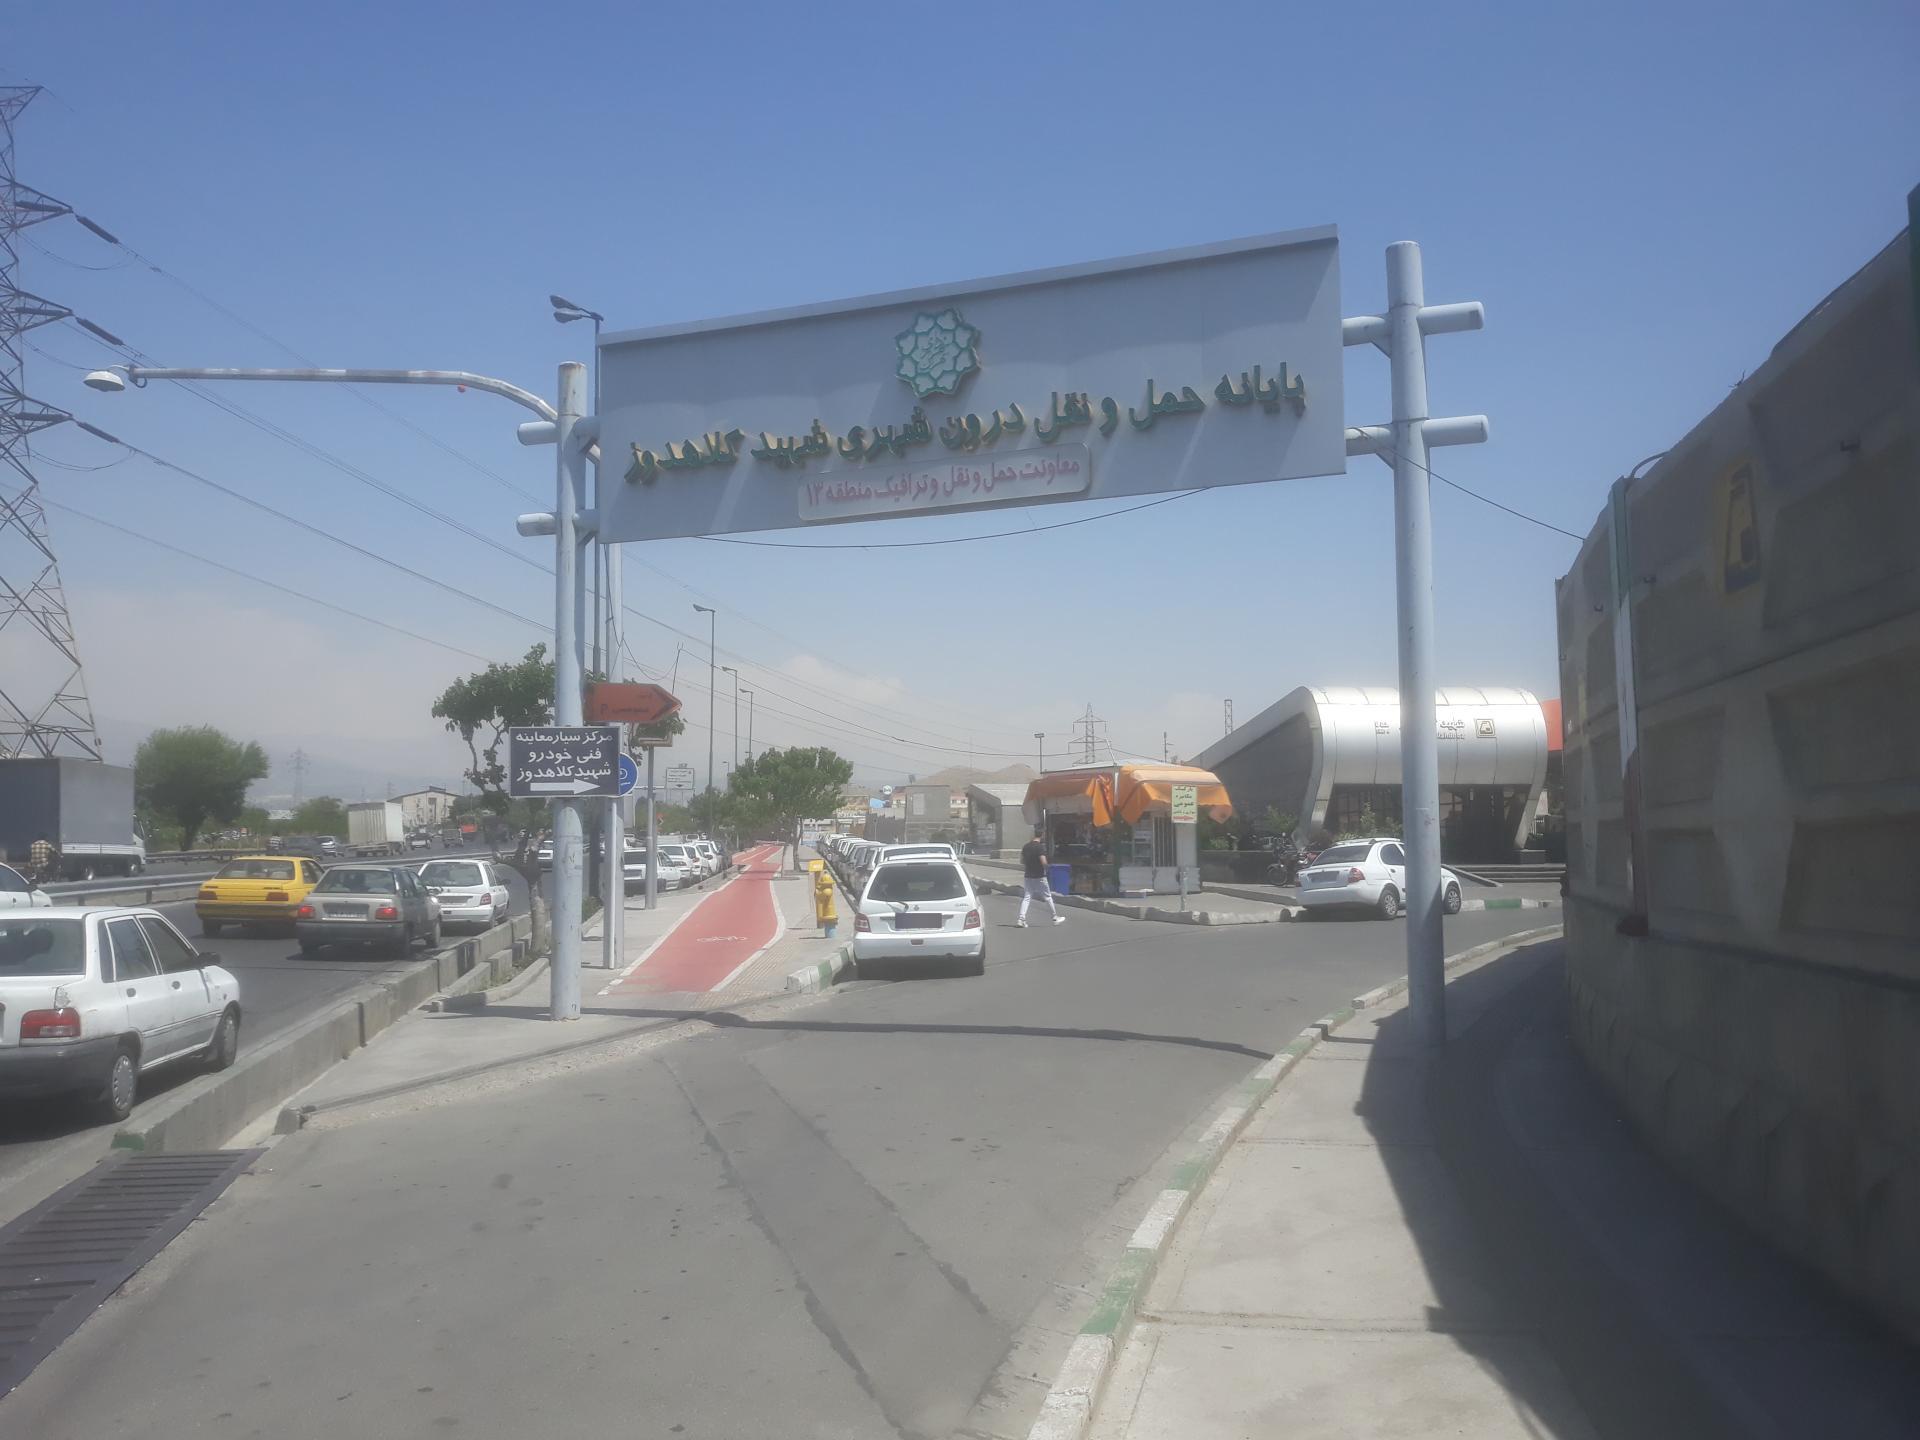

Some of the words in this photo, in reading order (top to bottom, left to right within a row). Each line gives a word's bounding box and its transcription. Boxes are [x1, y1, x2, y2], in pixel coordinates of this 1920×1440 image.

[1214, 362, 1306, 416] پایانه
[1034, 391, 1092, 442] نقل
[1100, 397, 1119, 435] و
[1129, 379, 1207, 431] حمل
[837, 406, 932, 460] شهری
[939, 402, 1025, 450] درون
[624, 428, 745, 484] کلاهدوز
[751, 418, 831, 468] شهید
[943, 465, 970, 496] نقل
[972, 471, 981, 494] و
[983, 462, 1017, 493] حمل
[1020, 452, 1080, 485] معاونت
[806, 481, 824, 506] ۱۳
[826, 481, 873, 501] منطقه
[874, 472, 928, 501] ترافیک
[930, 477, 939, 500] و
[516, 731, 553, 745] معاینه
[551, 731, 581, 745] سیار
[582, 731, 613, 745] مرکز
[528, 748, 572, 764] خودرو
[577, 747, 602, 764] فنی
[517, 765, 575, 782] کلاهدوز
[574, 761, 611, 780] شهید
